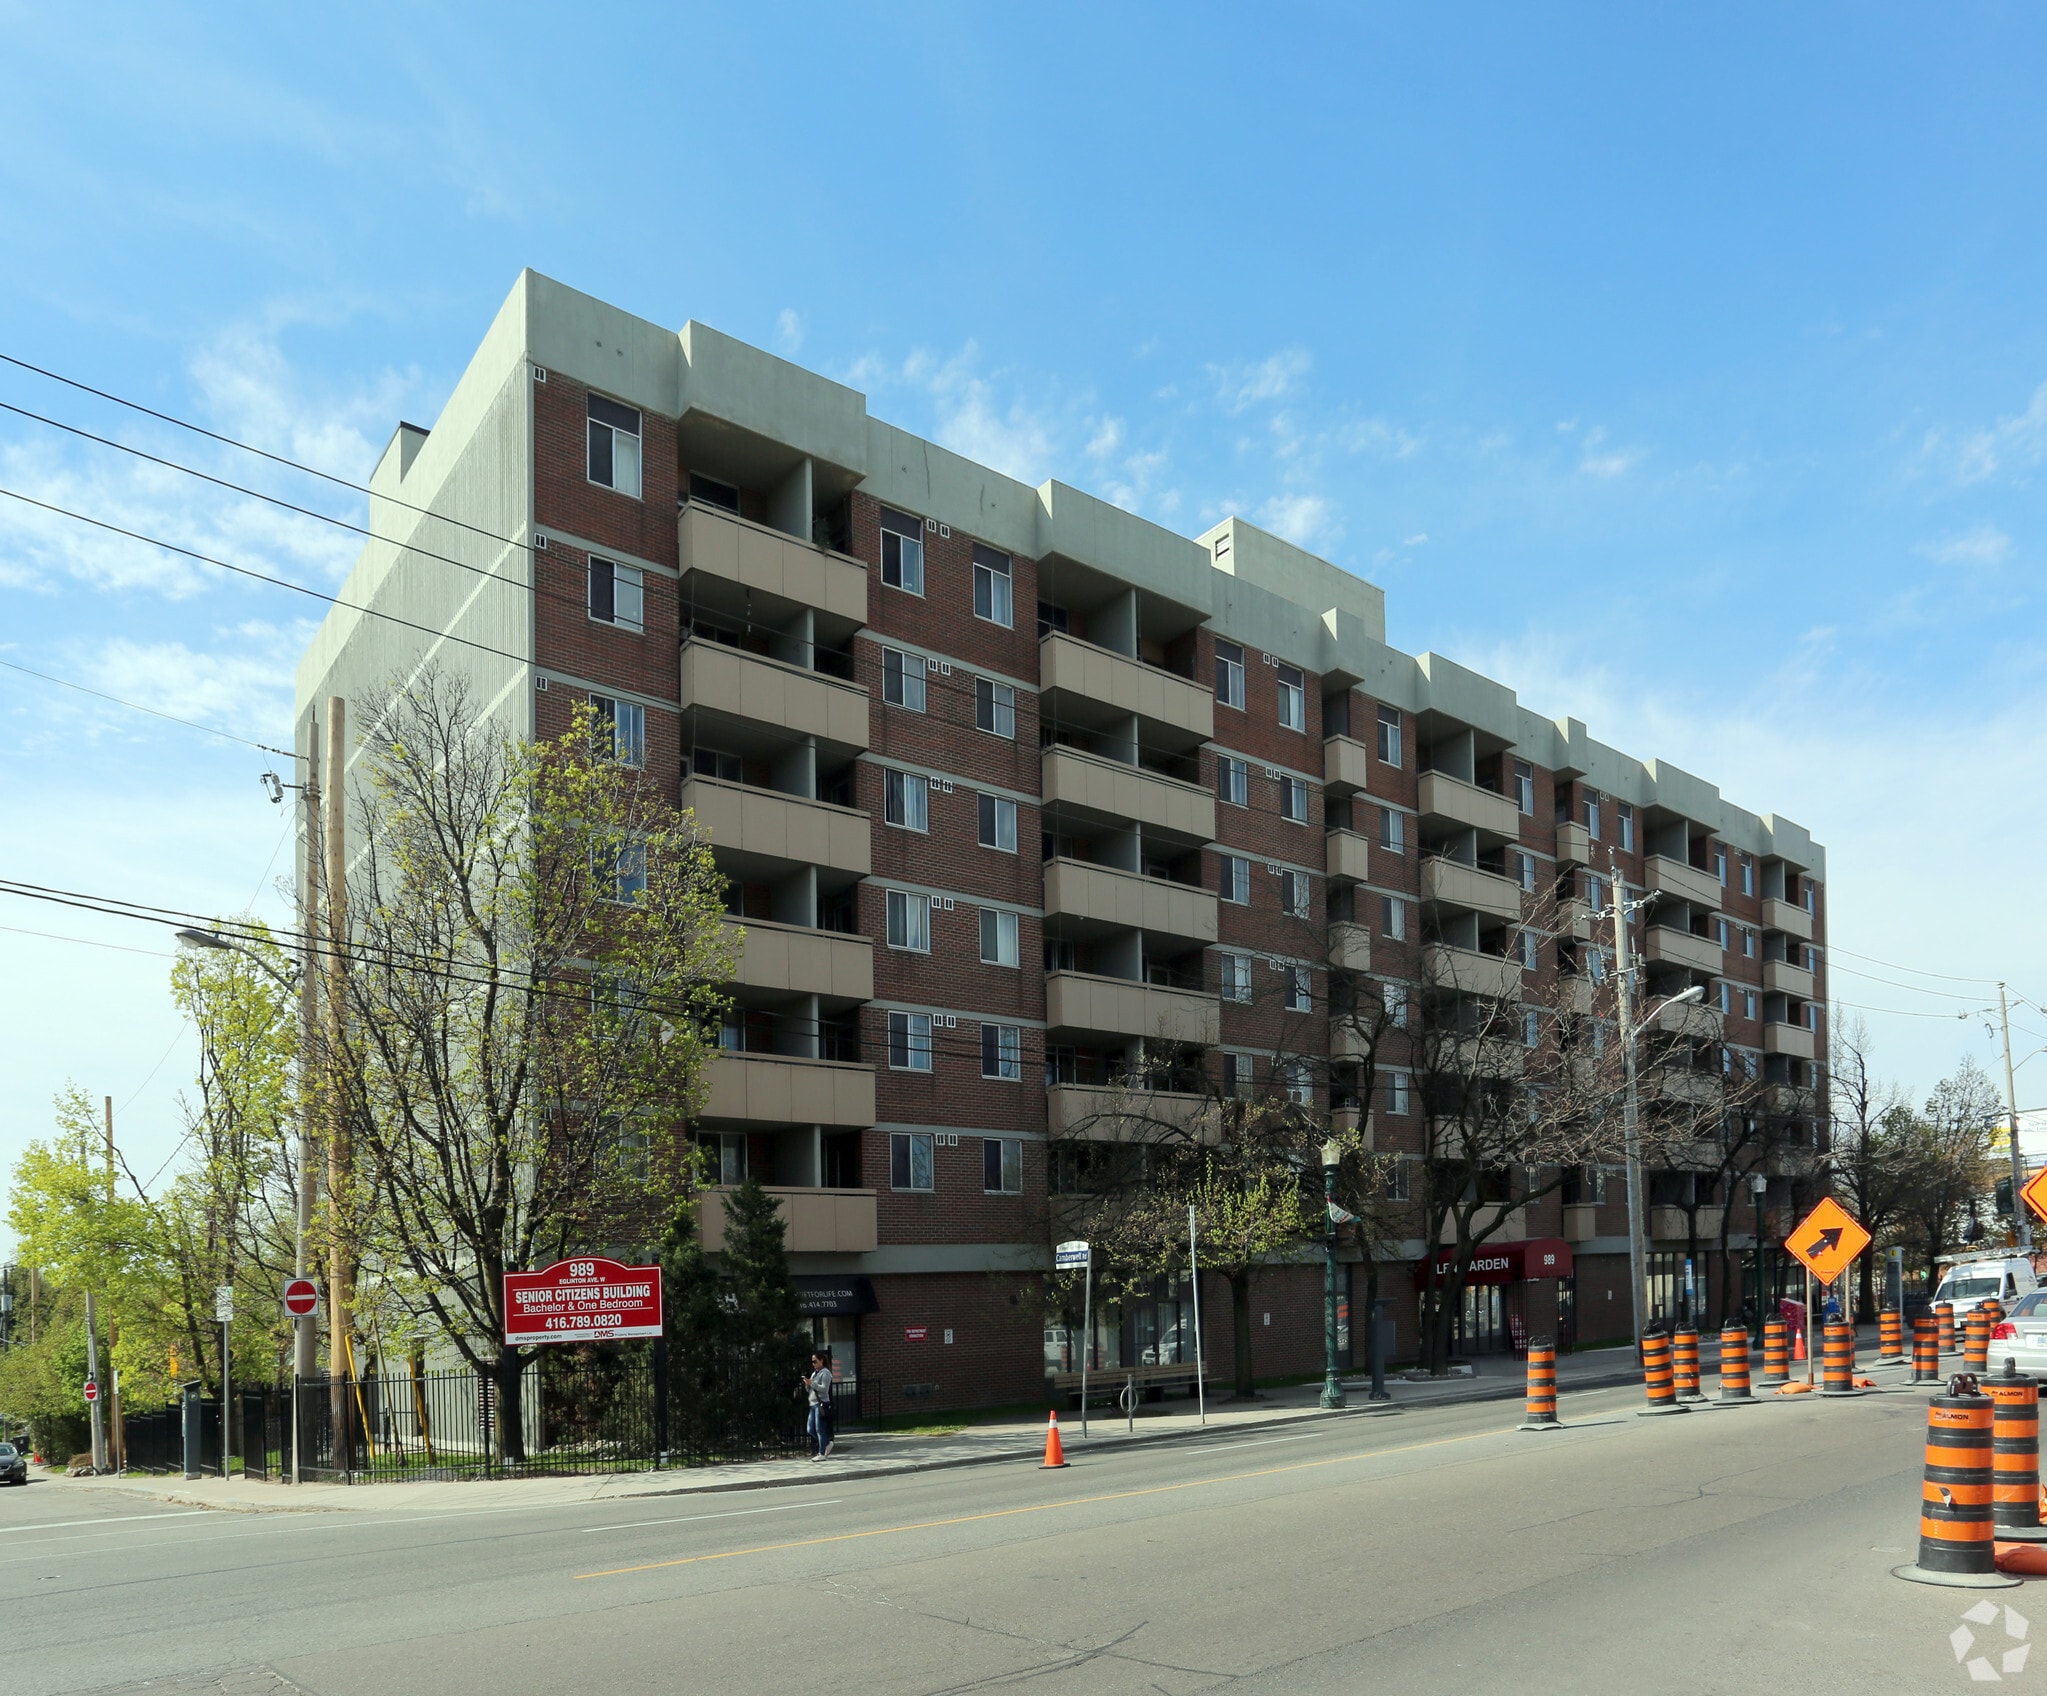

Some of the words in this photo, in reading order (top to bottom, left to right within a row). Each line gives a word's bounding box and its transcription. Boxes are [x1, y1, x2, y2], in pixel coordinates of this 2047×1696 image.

[1468, 1257, 1509, 1272] ARDEN
[1543, 1254, 1555, 1265] 989
[569, 1262, 595, 1277] 989
[515, 1290, 552, 1304] SENIOR
[555, 1287, 600, 1302] CITIZENS
[603, 1285, 651, 1299] BUILDING
[523, 1302, 565, 1313] Bachelor
[567, 1301, 575, 1311] &
[577, 1300, 597, 1310] One
[600, 1299, 643, 1309] Bedroom
[545, 1313, 622, 1329] 416.789.0820
[515, 1333, 562, 1342] dmsproperty.com
